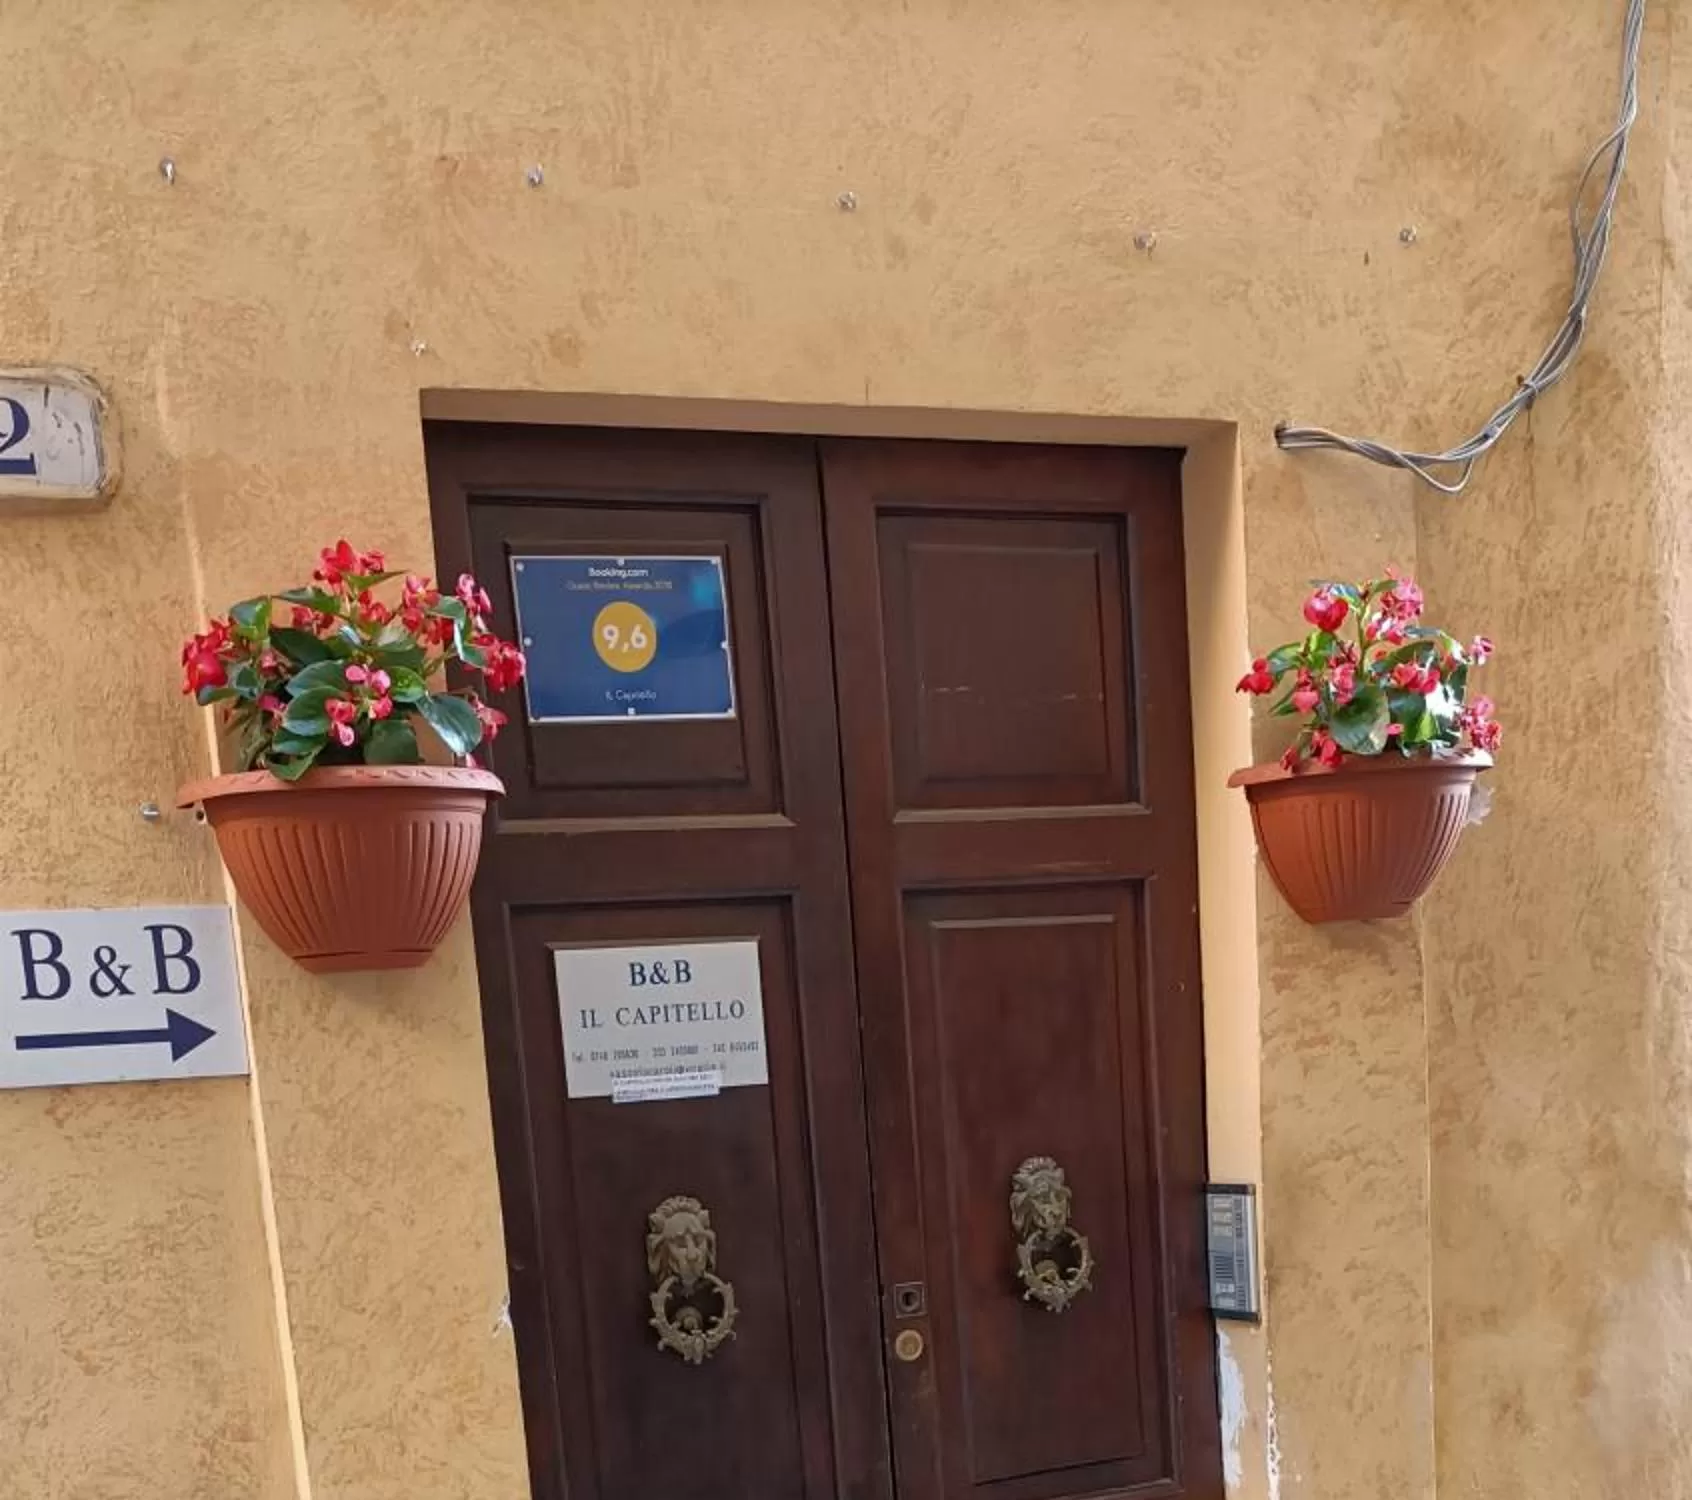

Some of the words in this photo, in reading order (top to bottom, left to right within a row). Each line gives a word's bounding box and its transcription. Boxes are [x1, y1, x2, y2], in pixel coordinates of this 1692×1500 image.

[0, 397, 37, 475] 2
[587, 567, 649, 579] Booking.com
[602, 623, 648, 653] 9,6
[628, 959, 692, 987] B&B
[580, 1008, 602, 1029] IL
[615, 999, 745, 1027] CAPITELLO
